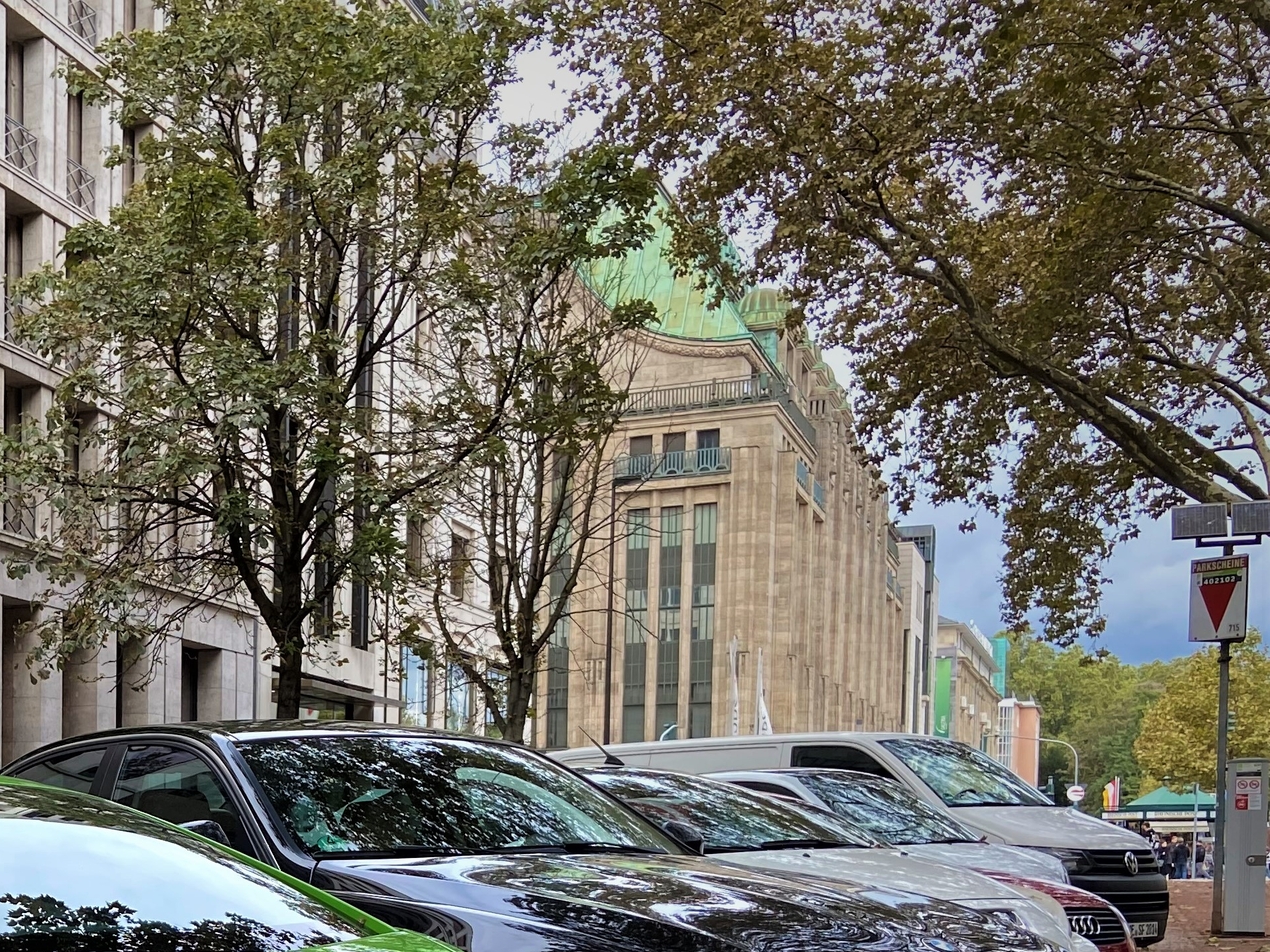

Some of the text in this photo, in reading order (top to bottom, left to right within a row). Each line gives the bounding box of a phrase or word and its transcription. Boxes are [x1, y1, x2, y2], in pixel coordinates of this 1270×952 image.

[1192, 557, 1245, 573] PARKSCHEINE
[1203, 576, 1236, 585] 402102
[1228, 624, 1240, 632] 715
